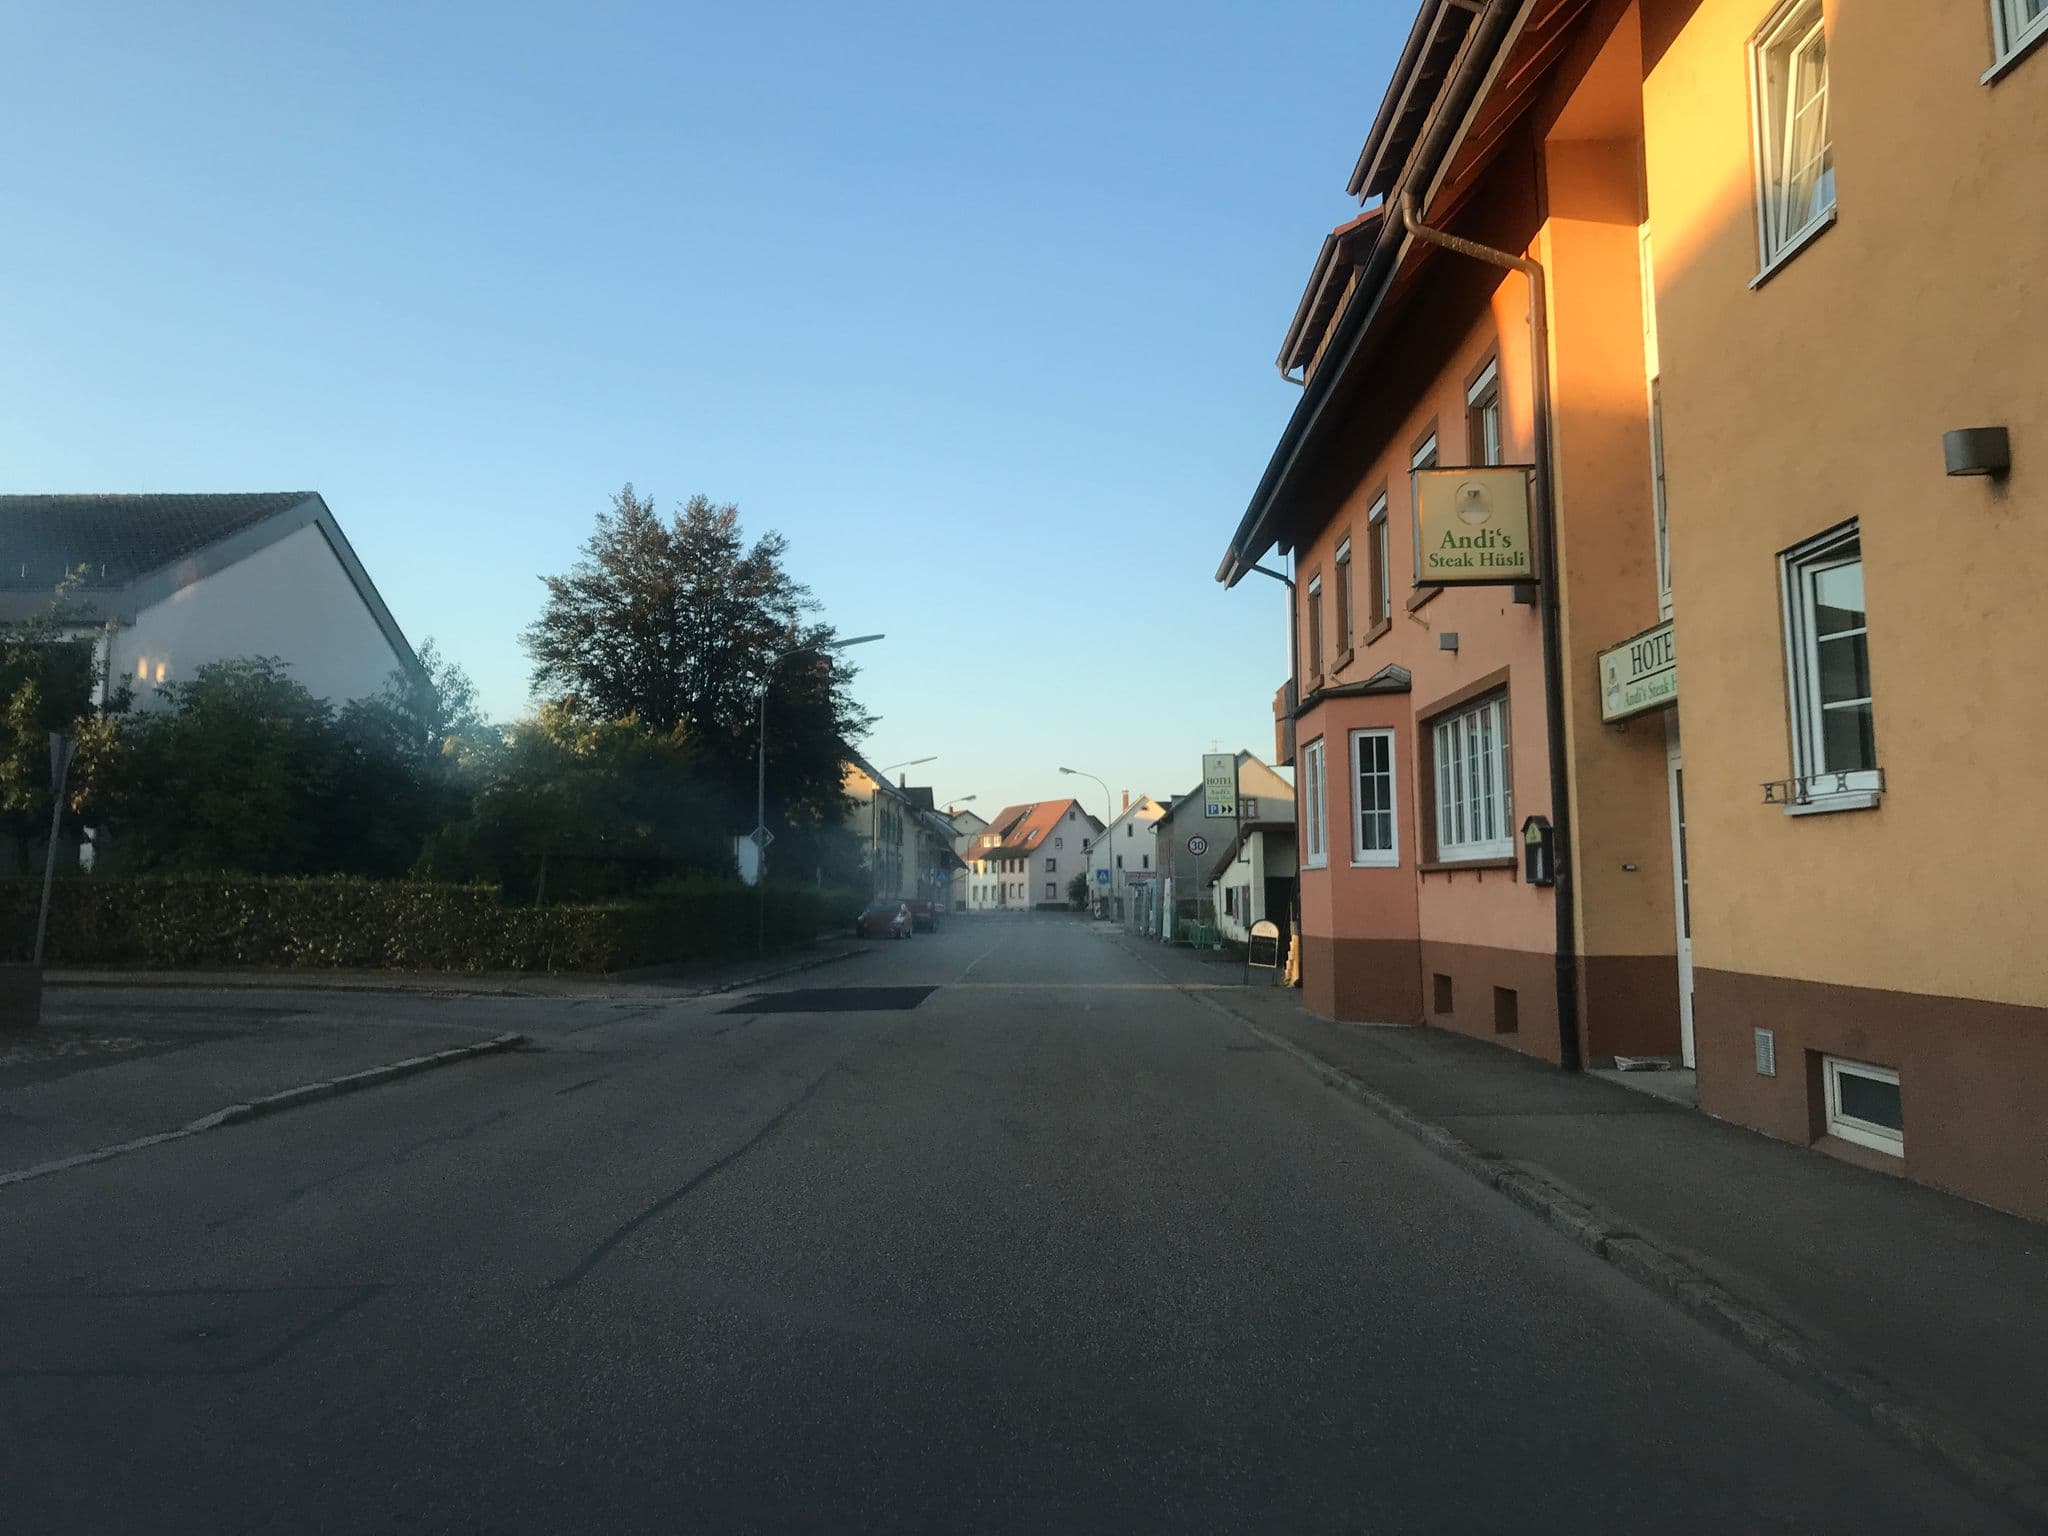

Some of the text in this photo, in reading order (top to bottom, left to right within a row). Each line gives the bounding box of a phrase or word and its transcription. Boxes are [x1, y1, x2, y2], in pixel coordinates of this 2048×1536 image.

[1440, 528, 1512, 549] Andi's
[1429, 551, 1525, 567] Steak Hüsli
[1630, 630, 1676, 676] HOTE
[1206, 777, 1232, 785] HOTEL
[1191, 841, 1204, 851] 30
